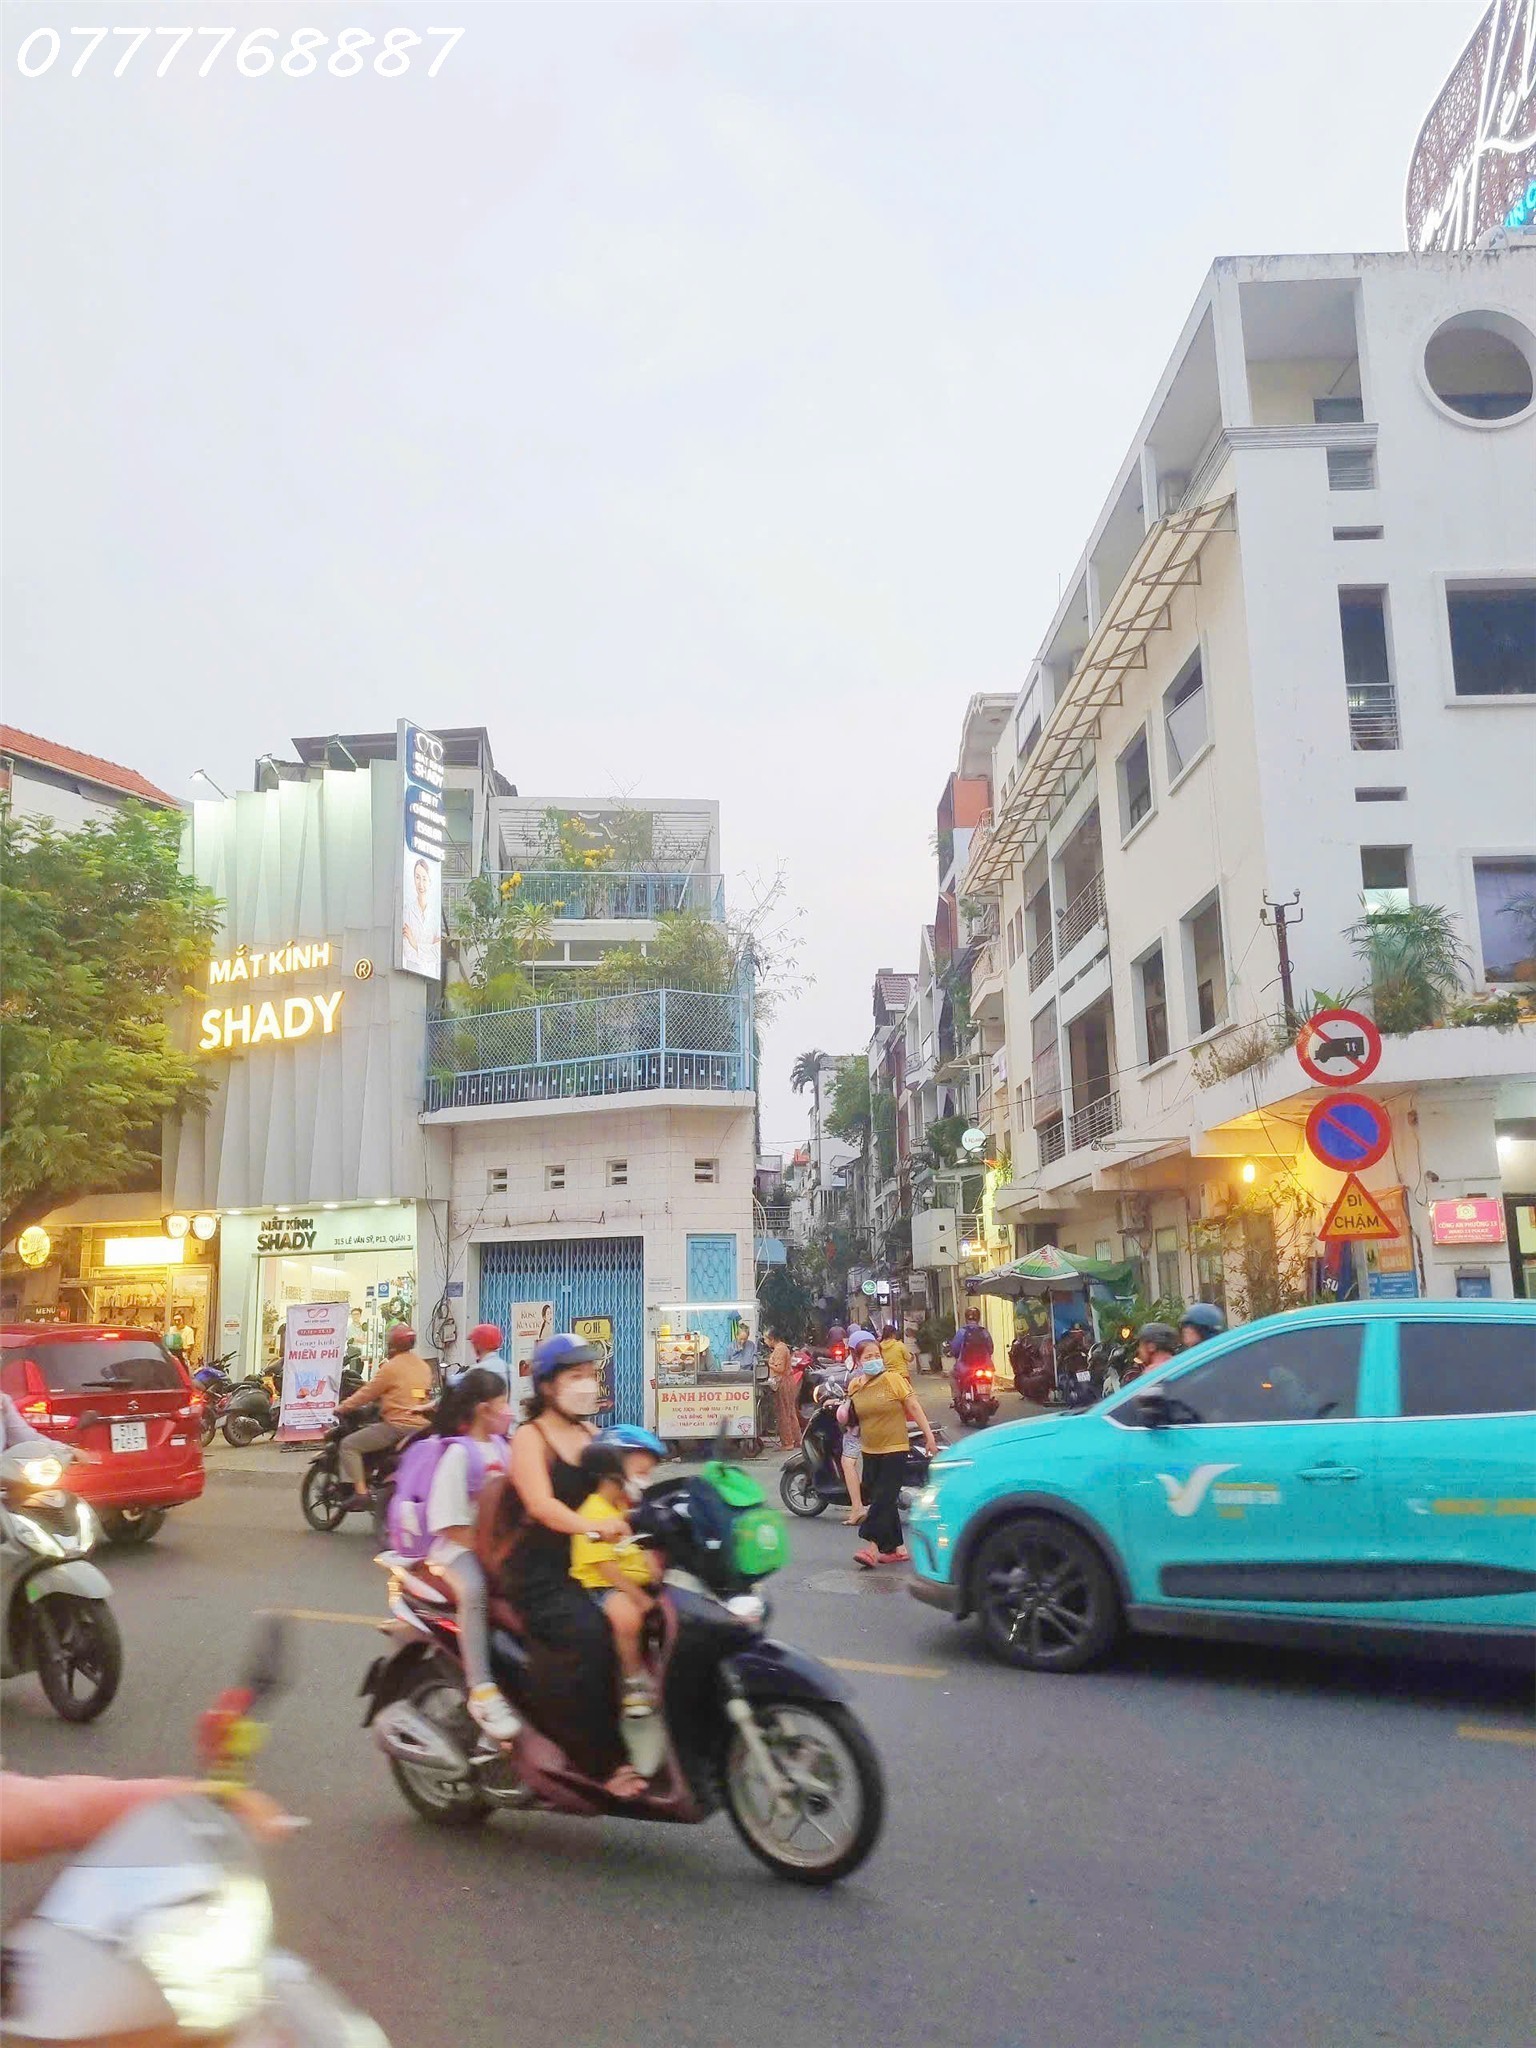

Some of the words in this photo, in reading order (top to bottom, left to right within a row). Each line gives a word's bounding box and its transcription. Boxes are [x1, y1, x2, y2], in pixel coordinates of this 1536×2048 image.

[209, 943, 266, 985] MẮT
[268, 940, 333, 976] KÍNH
[199, 990, 345, 1050] SHADY
[1347, 1194, 1362, 1207] ĐI
[1334, 1213, 1380, 1230] CHẬM
[257, 1231, 317, 1251] SHADY
[36, 1306, 56, 1315] MENU
[698, 1391, 723, 1402] HOT
[725, 1391, 750, 1401] DOG
